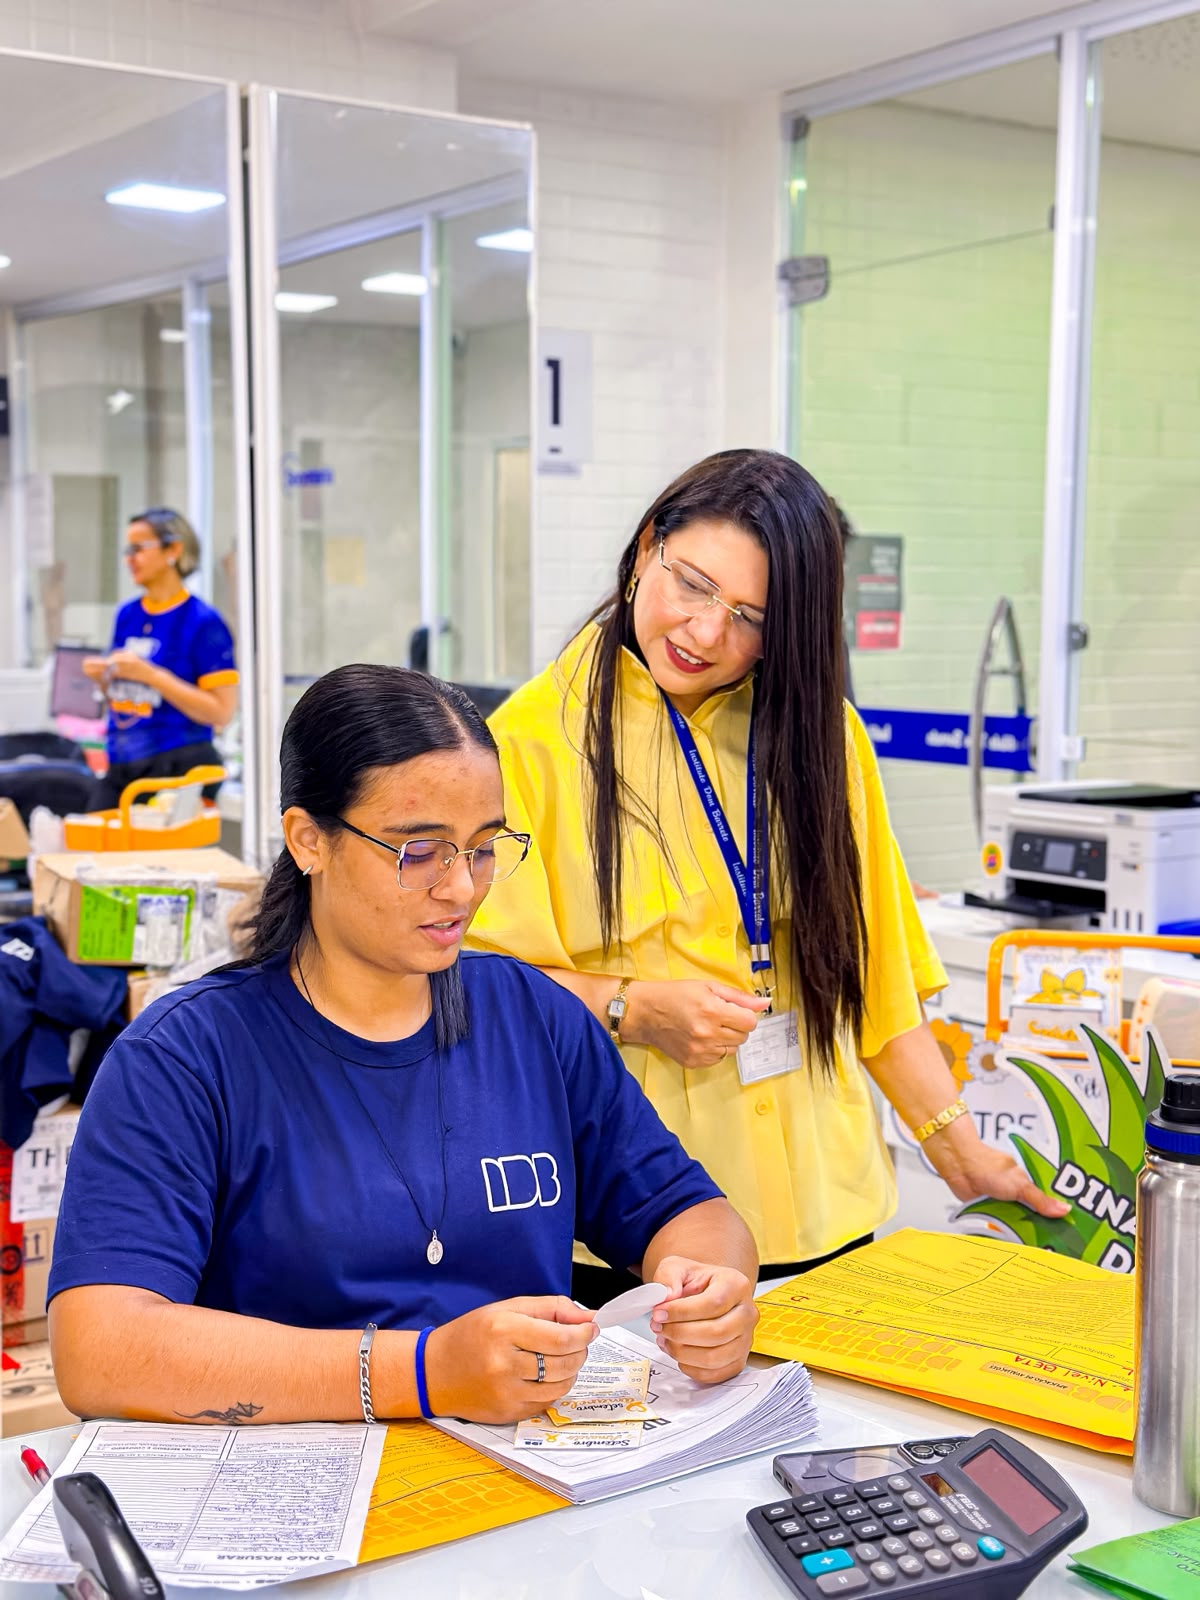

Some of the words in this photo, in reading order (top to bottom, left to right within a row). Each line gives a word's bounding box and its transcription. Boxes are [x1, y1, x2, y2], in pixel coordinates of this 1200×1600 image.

[546, 358, 560, 425] 1
[689, 749, 706, 784] Instituto
[703, 786, 715, 807] Dom
[711, 808, 729, 842] Barreto
[480, 1152, 561, 1213] IDB
[1014, 1354, 1057, 1373] BETA
[1034, 1375, 1068, 1390] APLICAÇÃO
[576, 1401, 624, 1412] setembro
[573, 1439, 630, 1447] Setembro
[878, 1501, 893, 1509] 8
[770, 1507, 785, 1515] 0
[846, 1508, 862, 1516] 5
[893, 1518, 908, 1526] 9
[781, 1521, 800, 1533] 00
[861, 1525, 877, 1533] 6
[829, 1532, 844, 1540] 3
